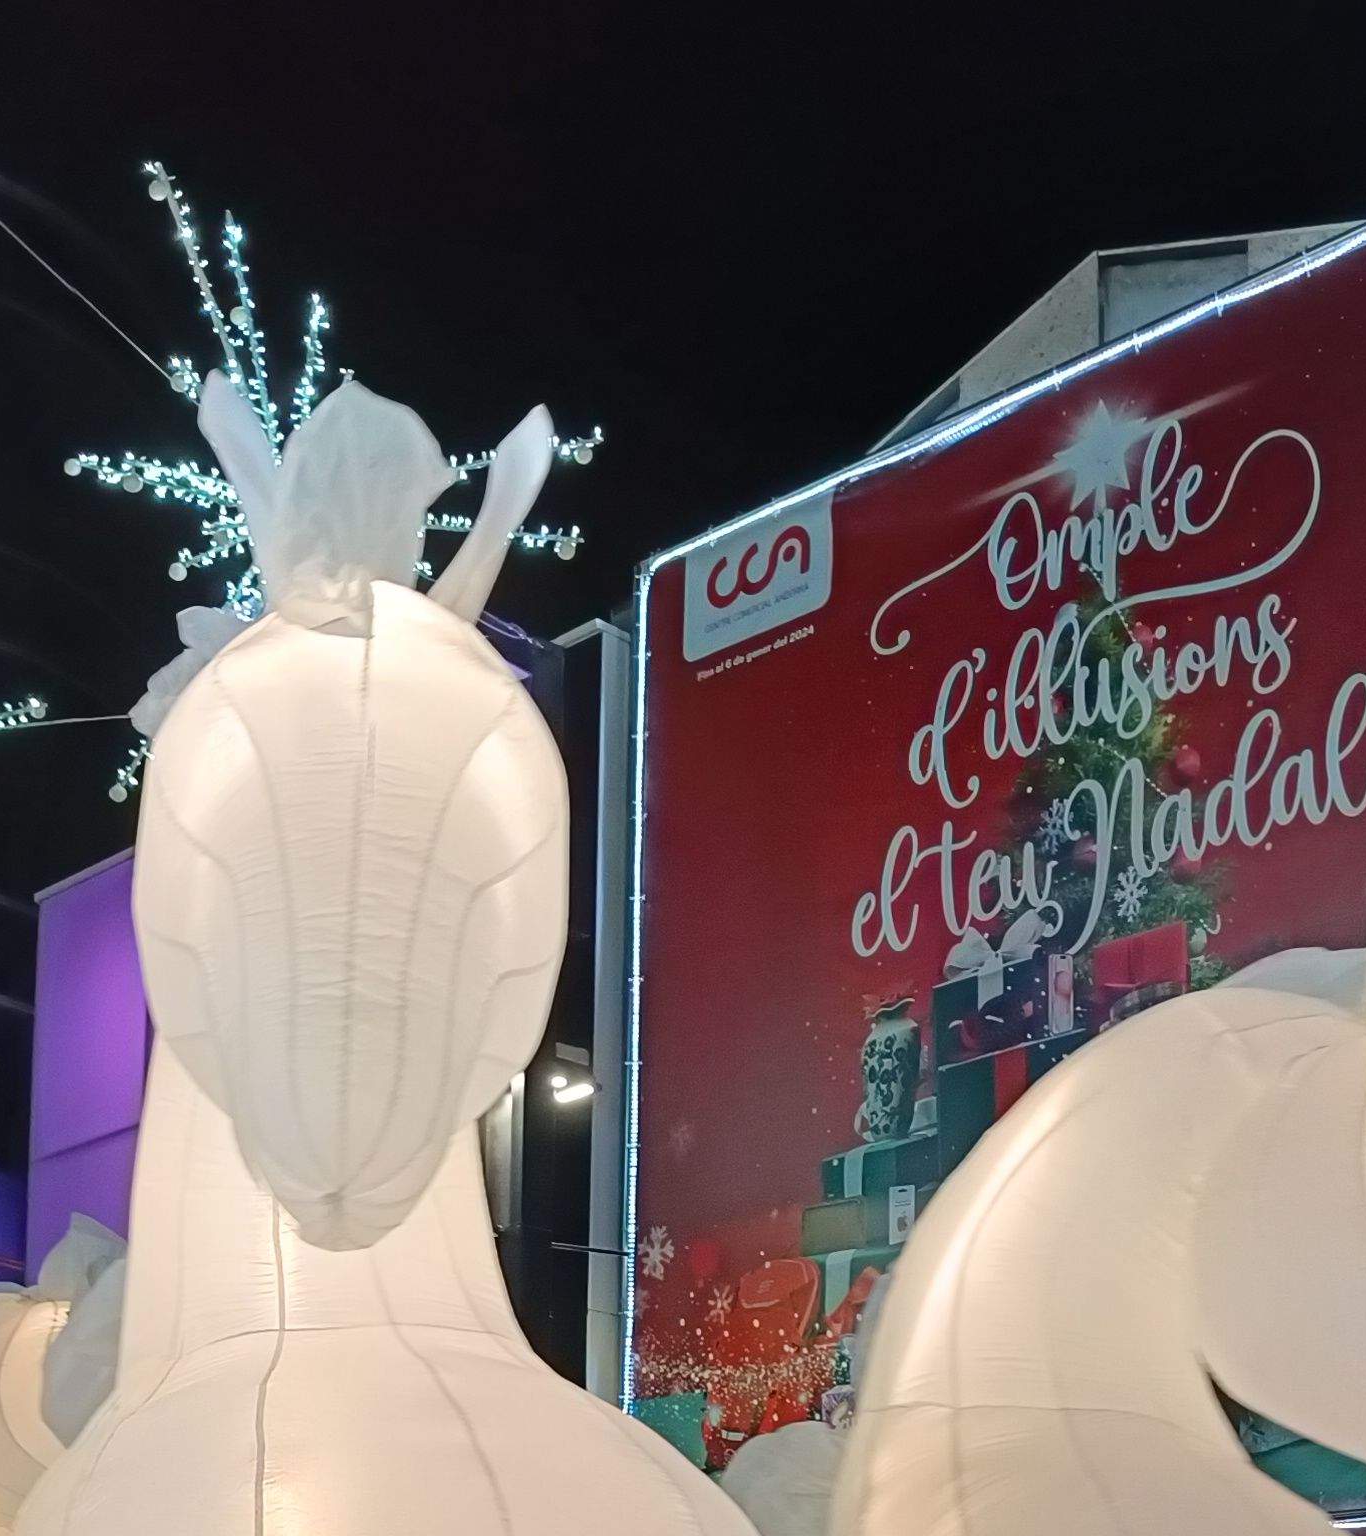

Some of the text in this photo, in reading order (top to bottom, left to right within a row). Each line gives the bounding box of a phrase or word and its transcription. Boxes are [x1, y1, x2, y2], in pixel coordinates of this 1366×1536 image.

[908, 593, 1297, 808] d'illusions
[851, 825, 919, 957] el
[916, 821, 1059, 938] teu
